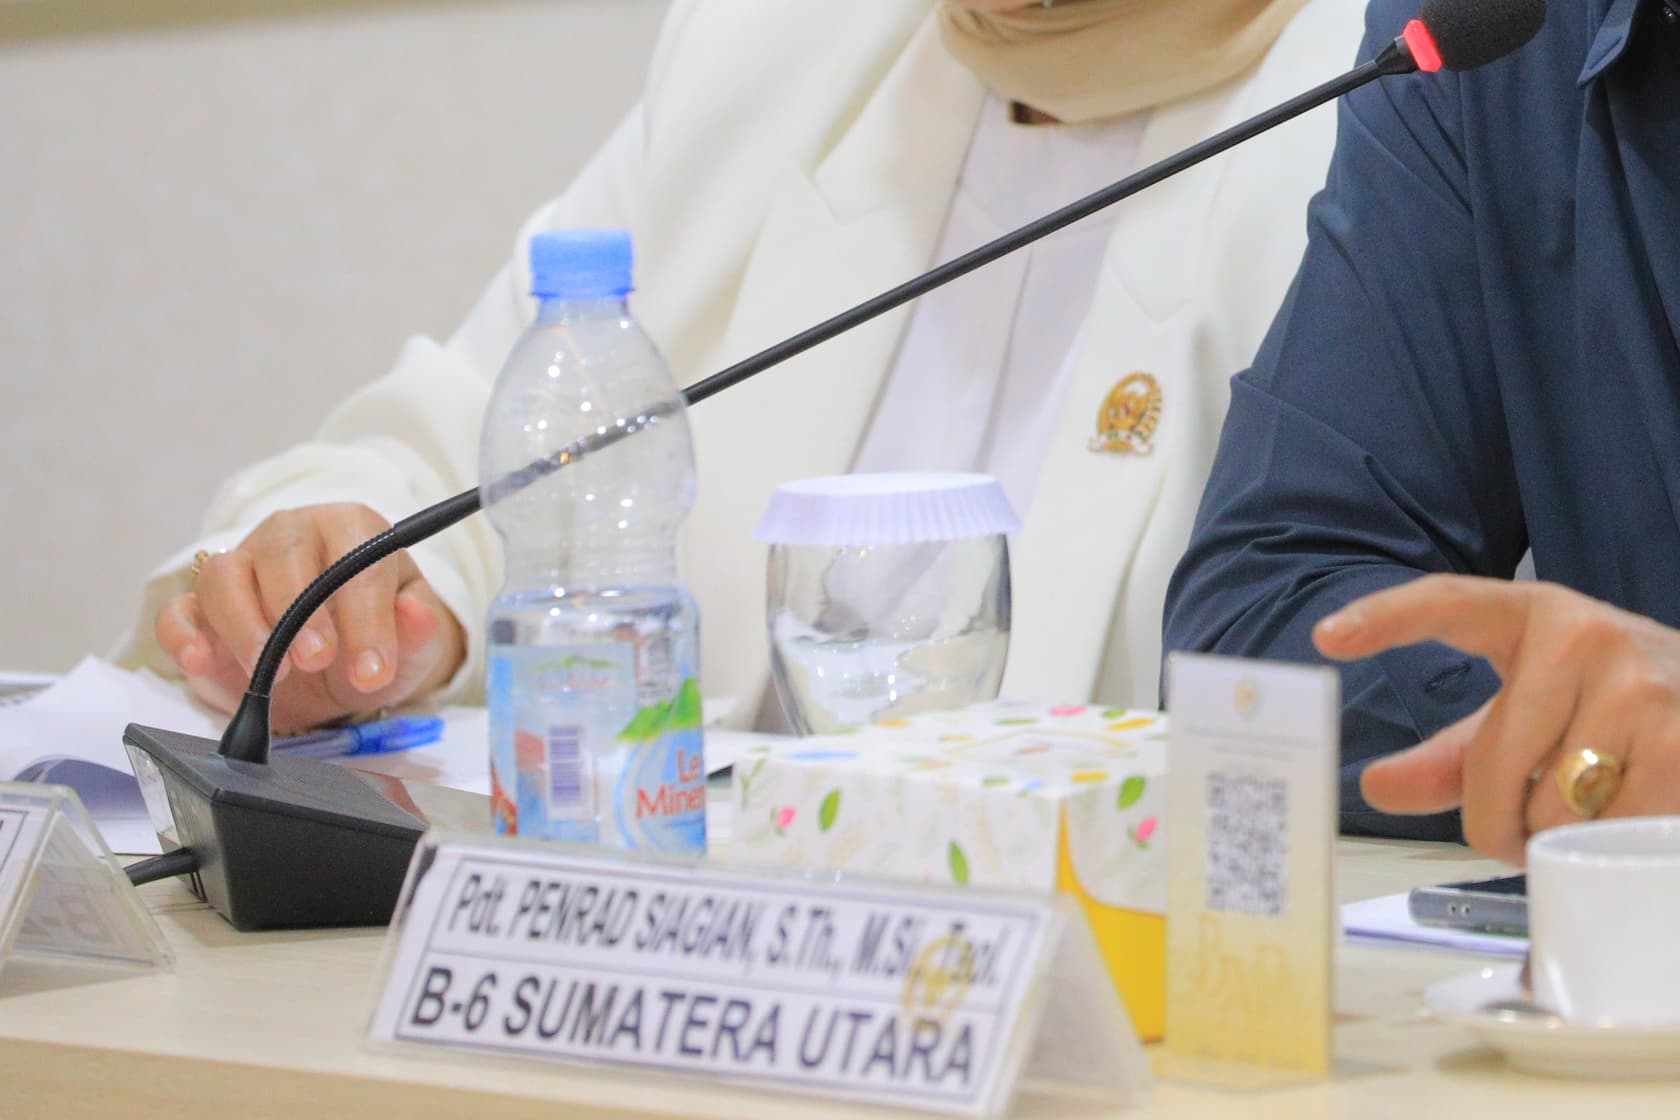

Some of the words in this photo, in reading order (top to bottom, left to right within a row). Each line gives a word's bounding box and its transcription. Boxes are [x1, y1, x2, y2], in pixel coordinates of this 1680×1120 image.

[452, 873, 505, 936] Pdt.
[508, 879, 639, 948] PENRAD
[634, 892, 767, 972] SIAGIAN,
[410, 966, 497, 1032] B-6
[503, 975, 781, 1067] SUMATERA
[797, 1006, 973, 1086] UTARA
